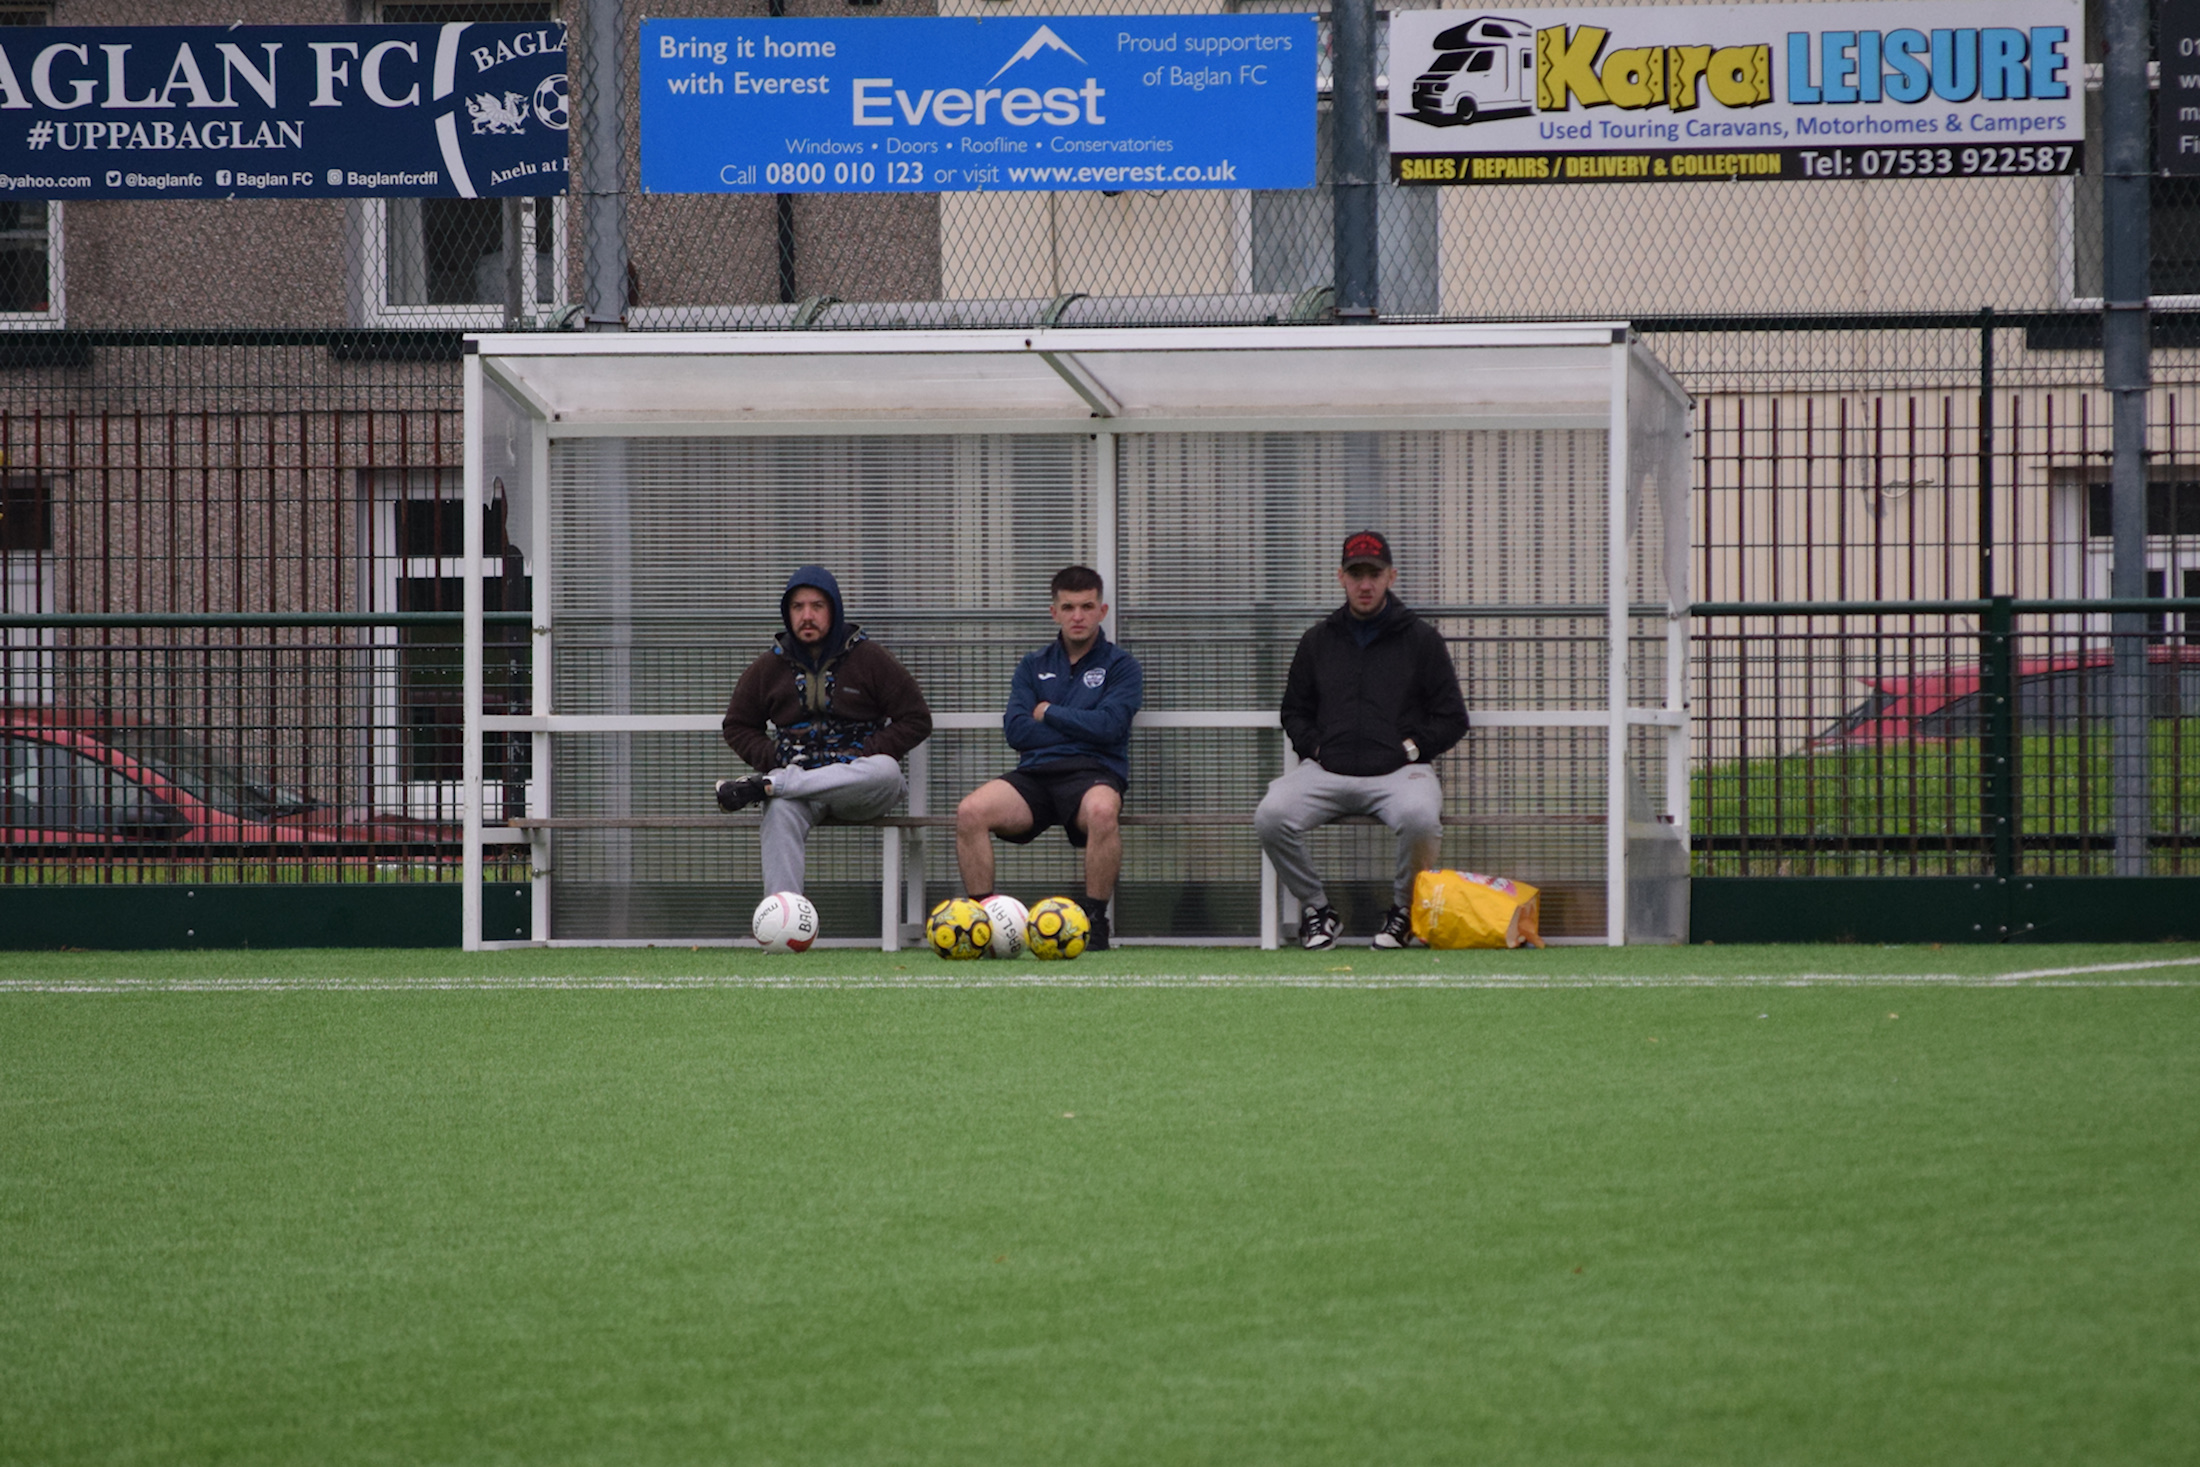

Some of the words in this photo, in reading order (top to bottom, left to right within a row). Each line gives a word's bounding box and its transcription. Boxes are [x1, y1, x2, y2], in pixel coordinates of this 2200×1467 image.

[660, 36, 728, 65] Bring
[737, 36, 755, 57] it
[764, 35, 836, 58] home
[1118, 32, 1177, 51] Proud
[1185, 34, 1292, 57] supporters
[308, 40, 420, 108] FC
[1143, 66, 1165, 86] of
[1170, 66, 1231, 91] Baglan
[1240, 65, 1268, 85] FC
[1537, 23, 1774, 113] Kara
[1787, 26, 2070, 105] LEISURE
[668, 72, 724, 94] with
[734, 72, 830, 94] Everest
[853, 78, 1106, 126] Everest
[27, 120, 304, 150] #UPPABAGLAN
[1540, 120, 1592, 139] Used
[1600, 120, 1679, 142] Touring
[1686, 119, 1789, 139] Caravans,
[1797, 115, 1938, 135] Motorhomes
[1945, 113, 1963, 132] &
[1970, 114, 2066, 135] Campers
[786, 139, 864, 154] Windows
[887, 137, 938, 154] Doors
[961, 136, 1028, 153] Roofline
[1051, 136, 1173, 153] Conservatories
[490, 161, 537, 186] Anelu
[542, 158, 558, 172] at
[720, 165, 757, 185] Call
[766, 162, 826, 185] 0800
[834, 162, 876, 184] 010
[887, 162, 924, 184] 123
[934, 167, 958, 183] or
[963, 163, 1000, 183] visit
[1008, 159, 1237, 182] www.everest.co.uk
[1401, 157, 1456, 180] SALES
[1472, 156, 1551, 179] REPAIRS
[1566, 155, 1650, 178] DELIVERY
[1653, 158, 1668, 176] &
[1671, 154, 1781, 175] COLLECTION
[1800, 150, 1853, 176] Tel:
[1861, 149, 1953, 175] 07533
[1961, 146, 2074, 173] 922587
[125, 172, 202, 189] @baglanfc
[237, 172, 288, 188] Baglan
[292, 172, 313, 186] FC
[347, 170, 438, 188] Baglanfcrdfl
